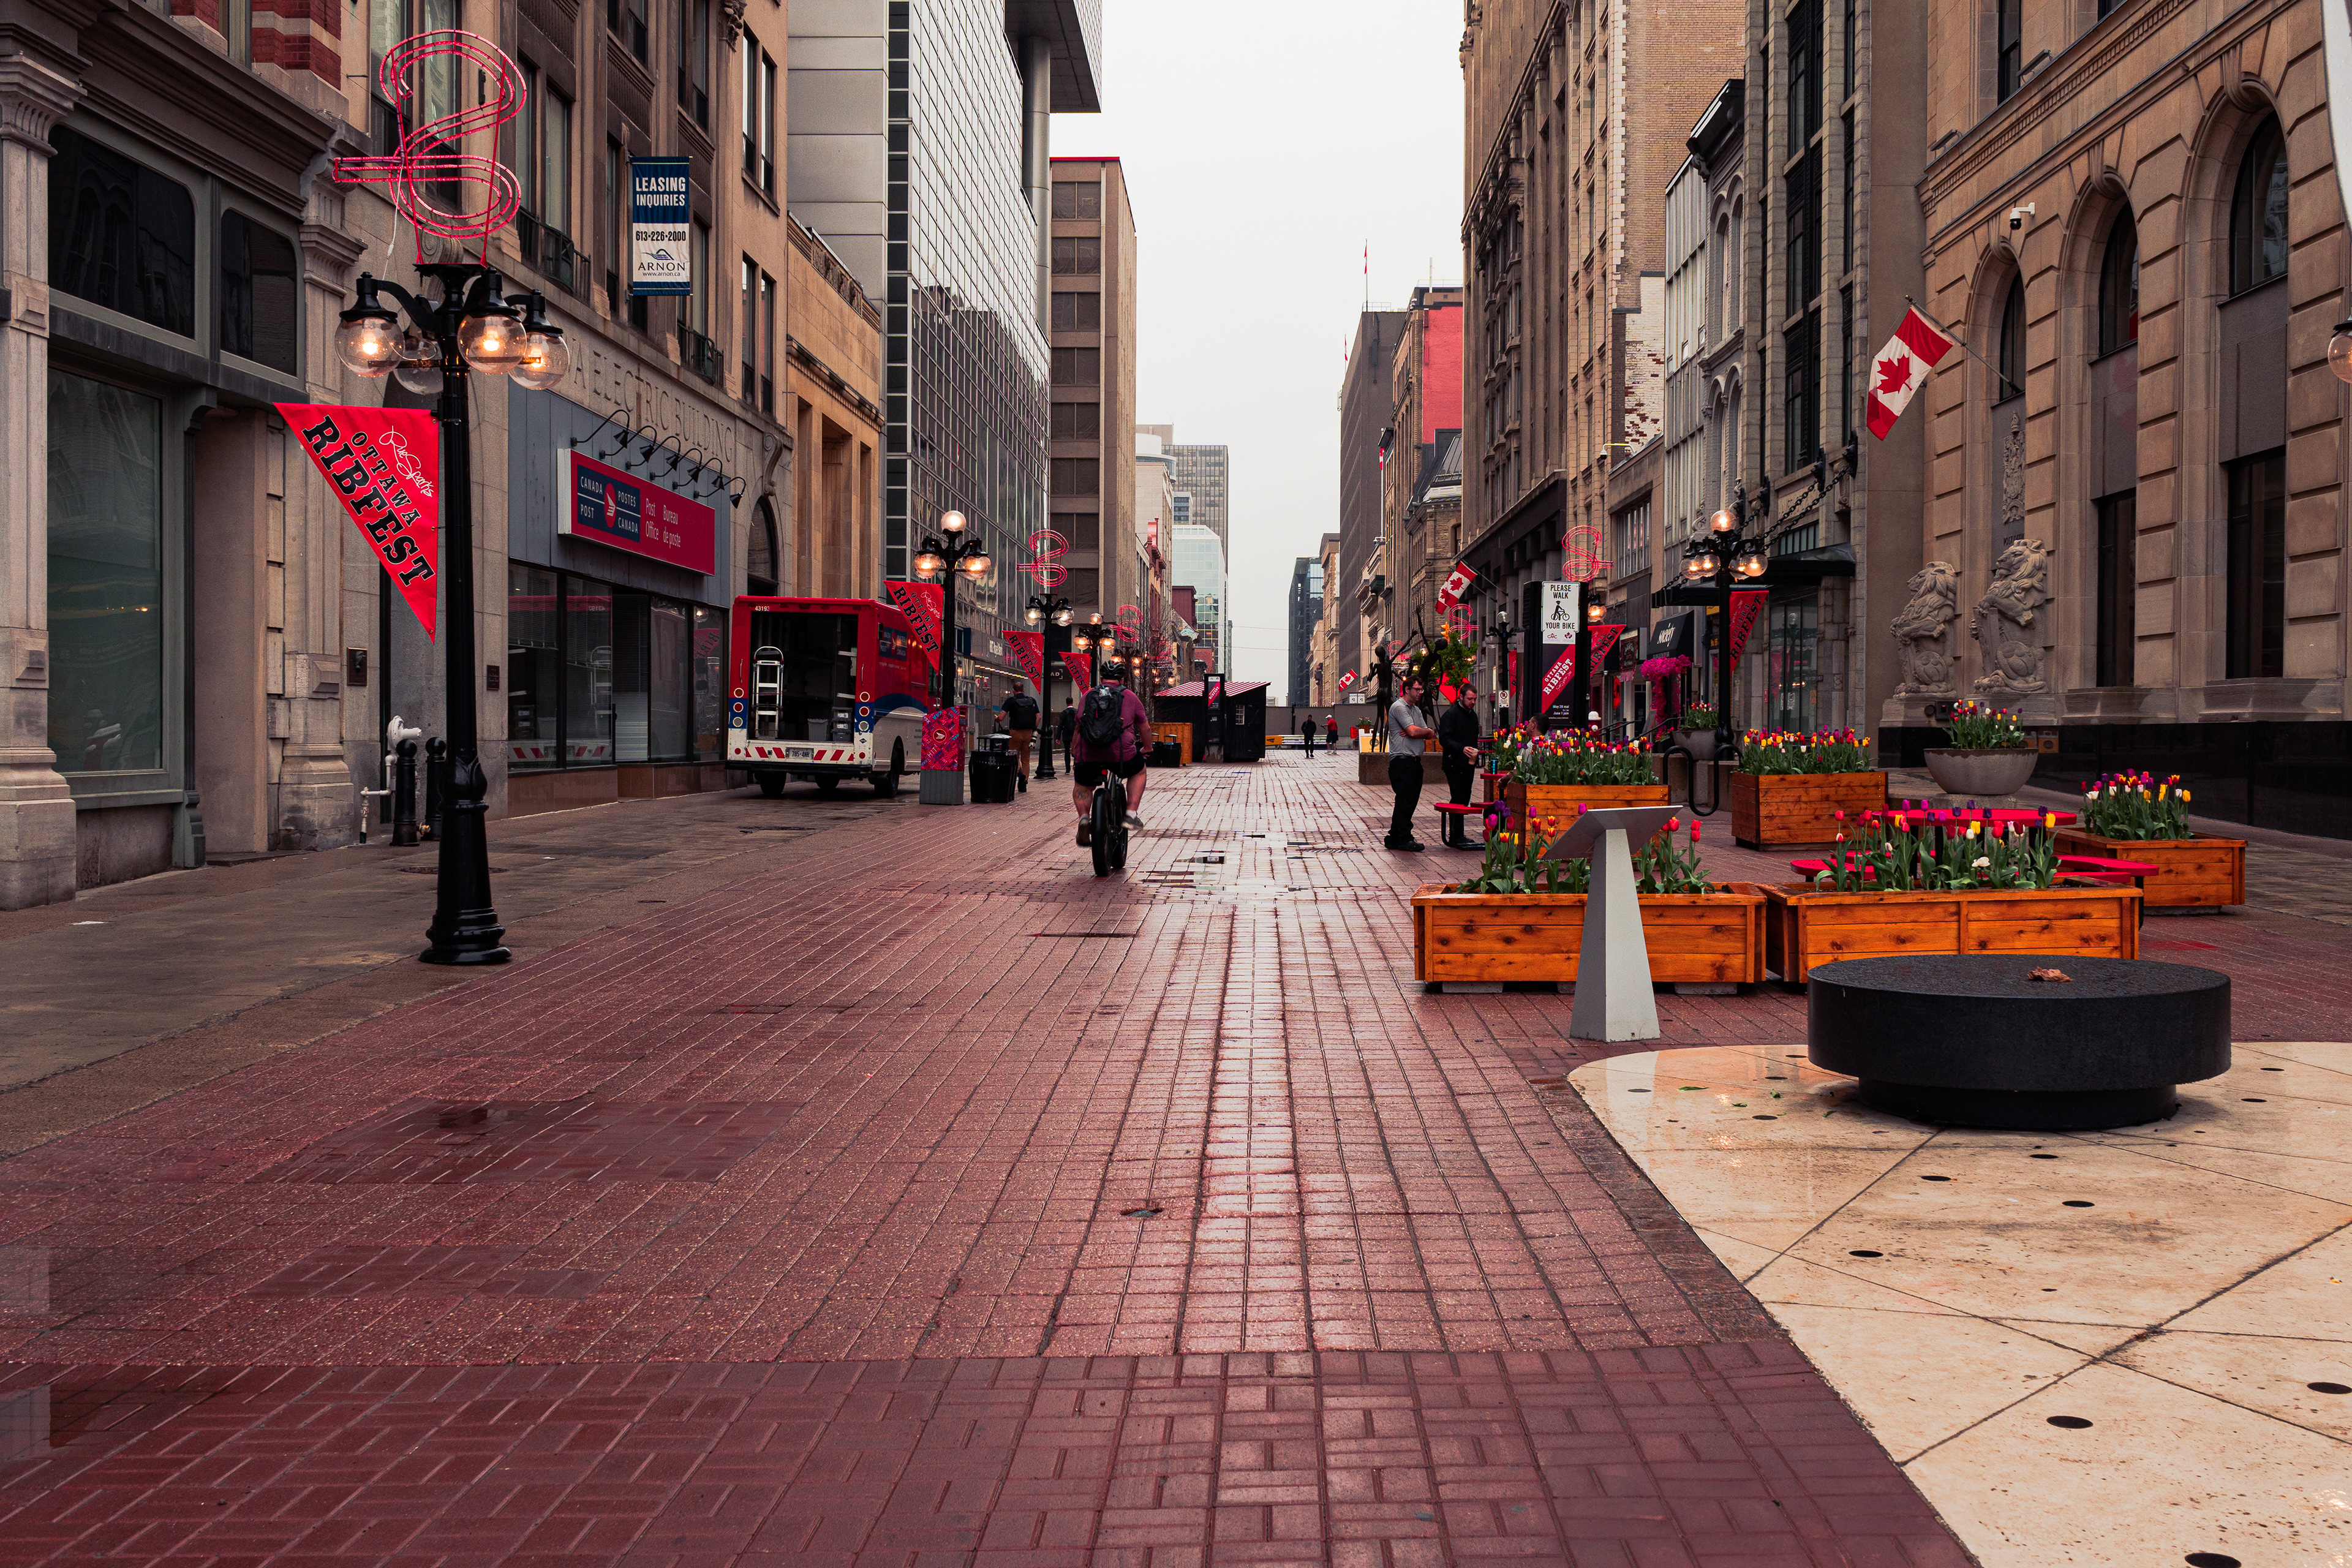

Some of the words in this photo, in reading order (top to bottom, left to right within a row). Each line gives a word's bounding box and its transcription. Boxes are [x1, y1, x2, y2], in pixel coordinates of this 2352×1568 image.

[636, 177, 685, 192] LEASING
[636, 194, 685, 208] INQUIRIES
[638, 262, 685, 271] ARNON
[593, 350, 669, 430] ELECTRIC
[674, 397, 733, 463] BUILDING
[351, 431, 421, 526] OTTAWA
[581, 476, 603, 495] CANADA
[301, 415, 435, 587] RIBFEST
[618, 491, 636, 507] POSTES
[646, 498, 655, 516] Post
[581, 503, 594, 519] POST
[663, 505, 678, 525] Bureau
[618, 518, 638, 533] CANADA
[646, 521, 659, 540] Office
[663, 526, 668, 543] de
[669, 531, 681, 548] poste
[892, 586, 940, 654] RIBFEST
[910, 592, 935, 630] OTTAWA
[1730, 594, 1762, 662] RIBFEST
[1009, 634, 1041, 680] RIBFEST
[1064, 655, 1088, 690] RIBFEST
[1543, 658, 1573, 695] RIBFEST
[1544, 662, 1562, 682] OTTAWA
